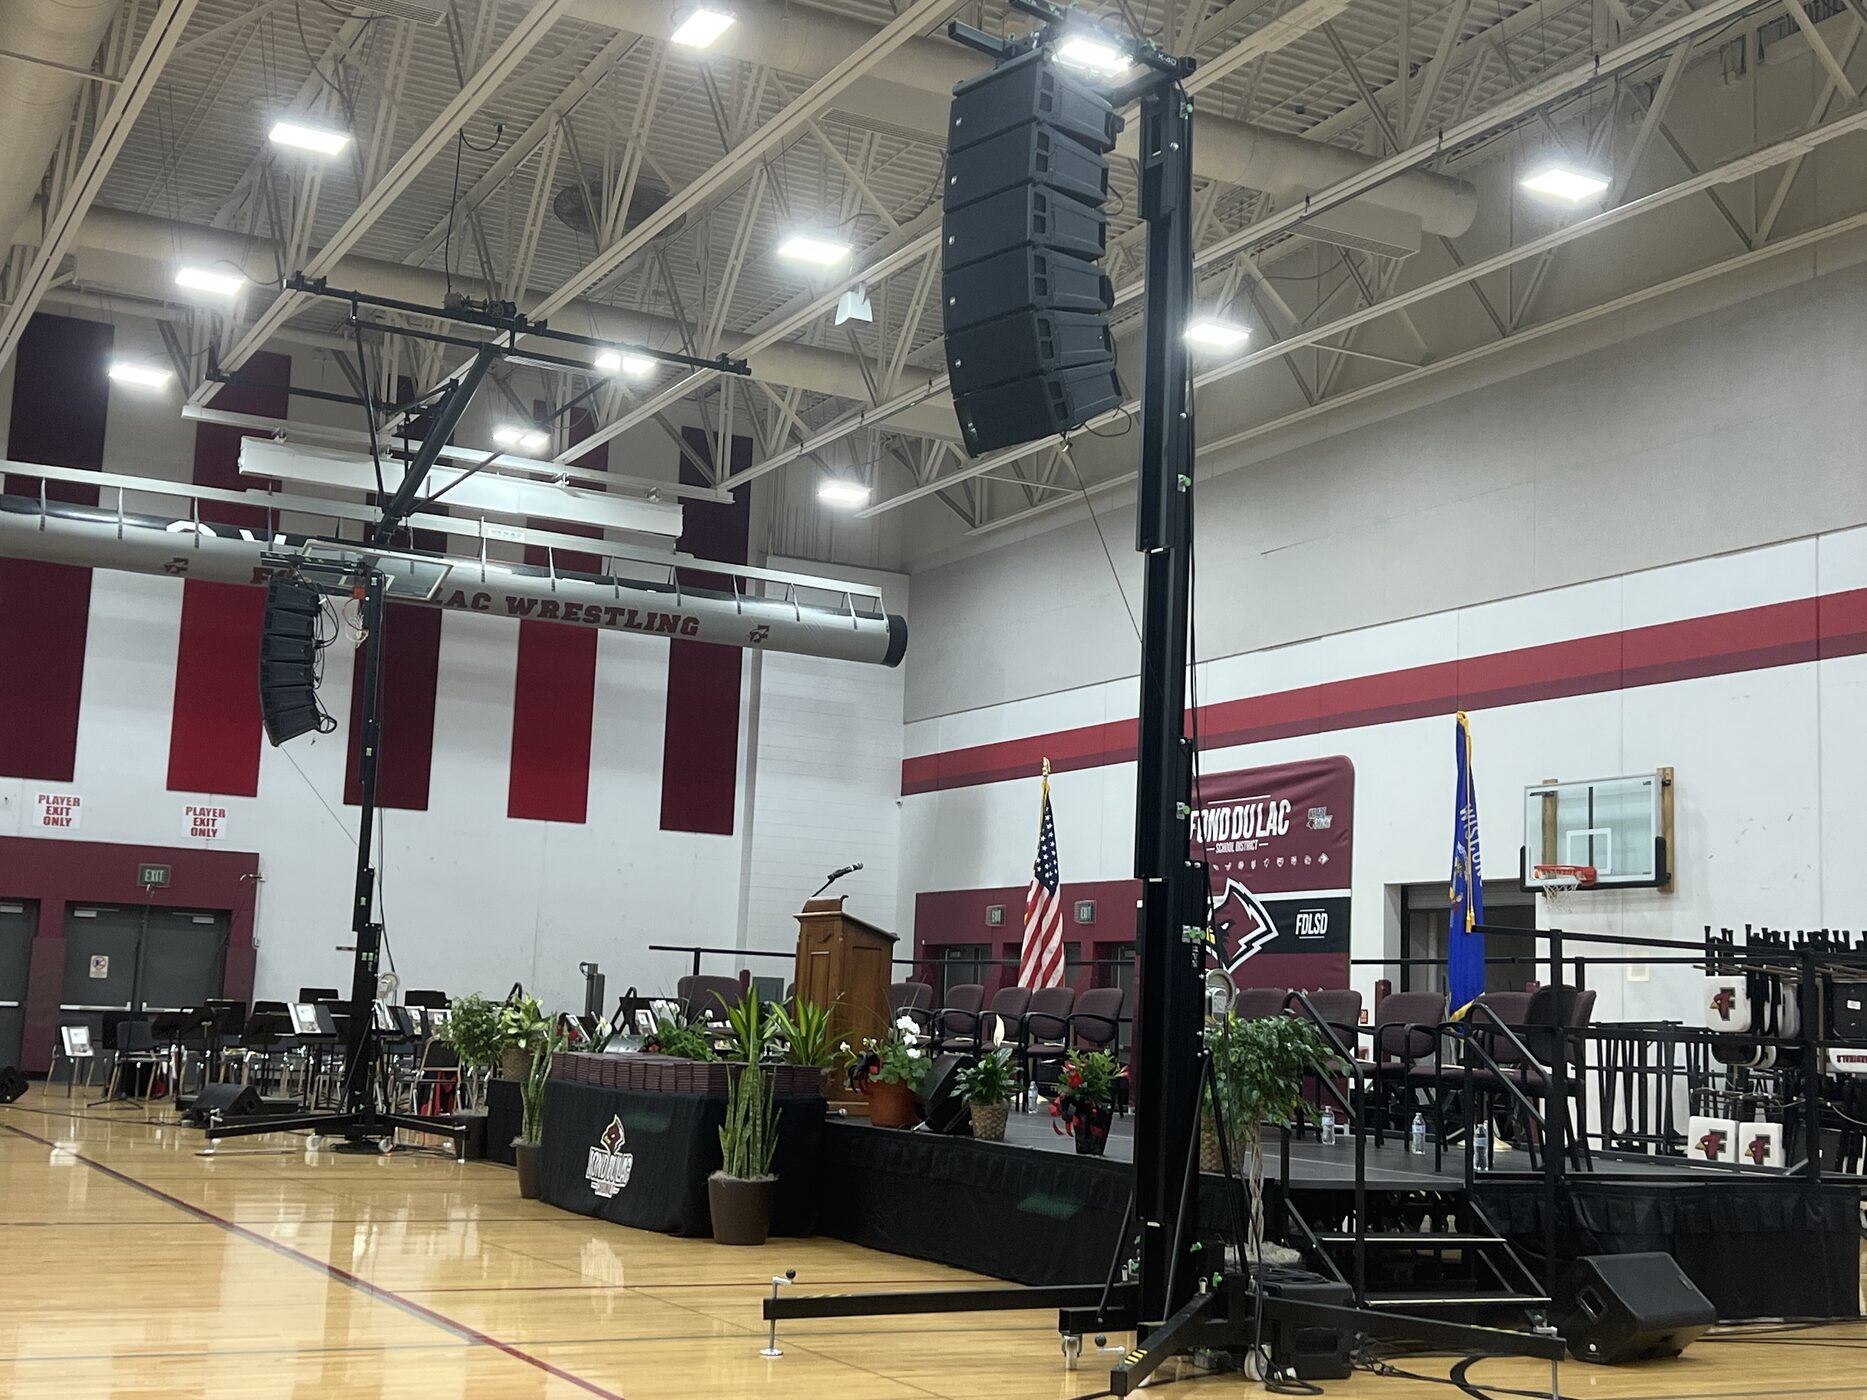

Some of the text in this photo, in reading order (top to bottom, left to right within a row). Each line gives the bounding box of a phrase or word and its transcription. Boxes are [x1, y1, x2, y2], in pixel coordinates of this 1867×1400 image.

[505, 596, 700, 637] WRESTLING
[38, 794, 81, 807] PLAYER
[46, 805, 72, 816] EXIT
[185, 806, 226, 818] PLAYER
[43, 815, 72, 827] ONLY
[193, 817, 218, 827] EXIT
[1190, 807, 1231, 843] FOND
[1231, 803, 1257, 840] DU
[1256, 799, 1291, 838] LAC
[190, 827, 218, 838] ONLY
[1215, 839, 1259, 853] SCHOOL DISTRICT
[144, 869, 165, 882] EXIT
[1295, 912, 1329, 935] FDLSD
